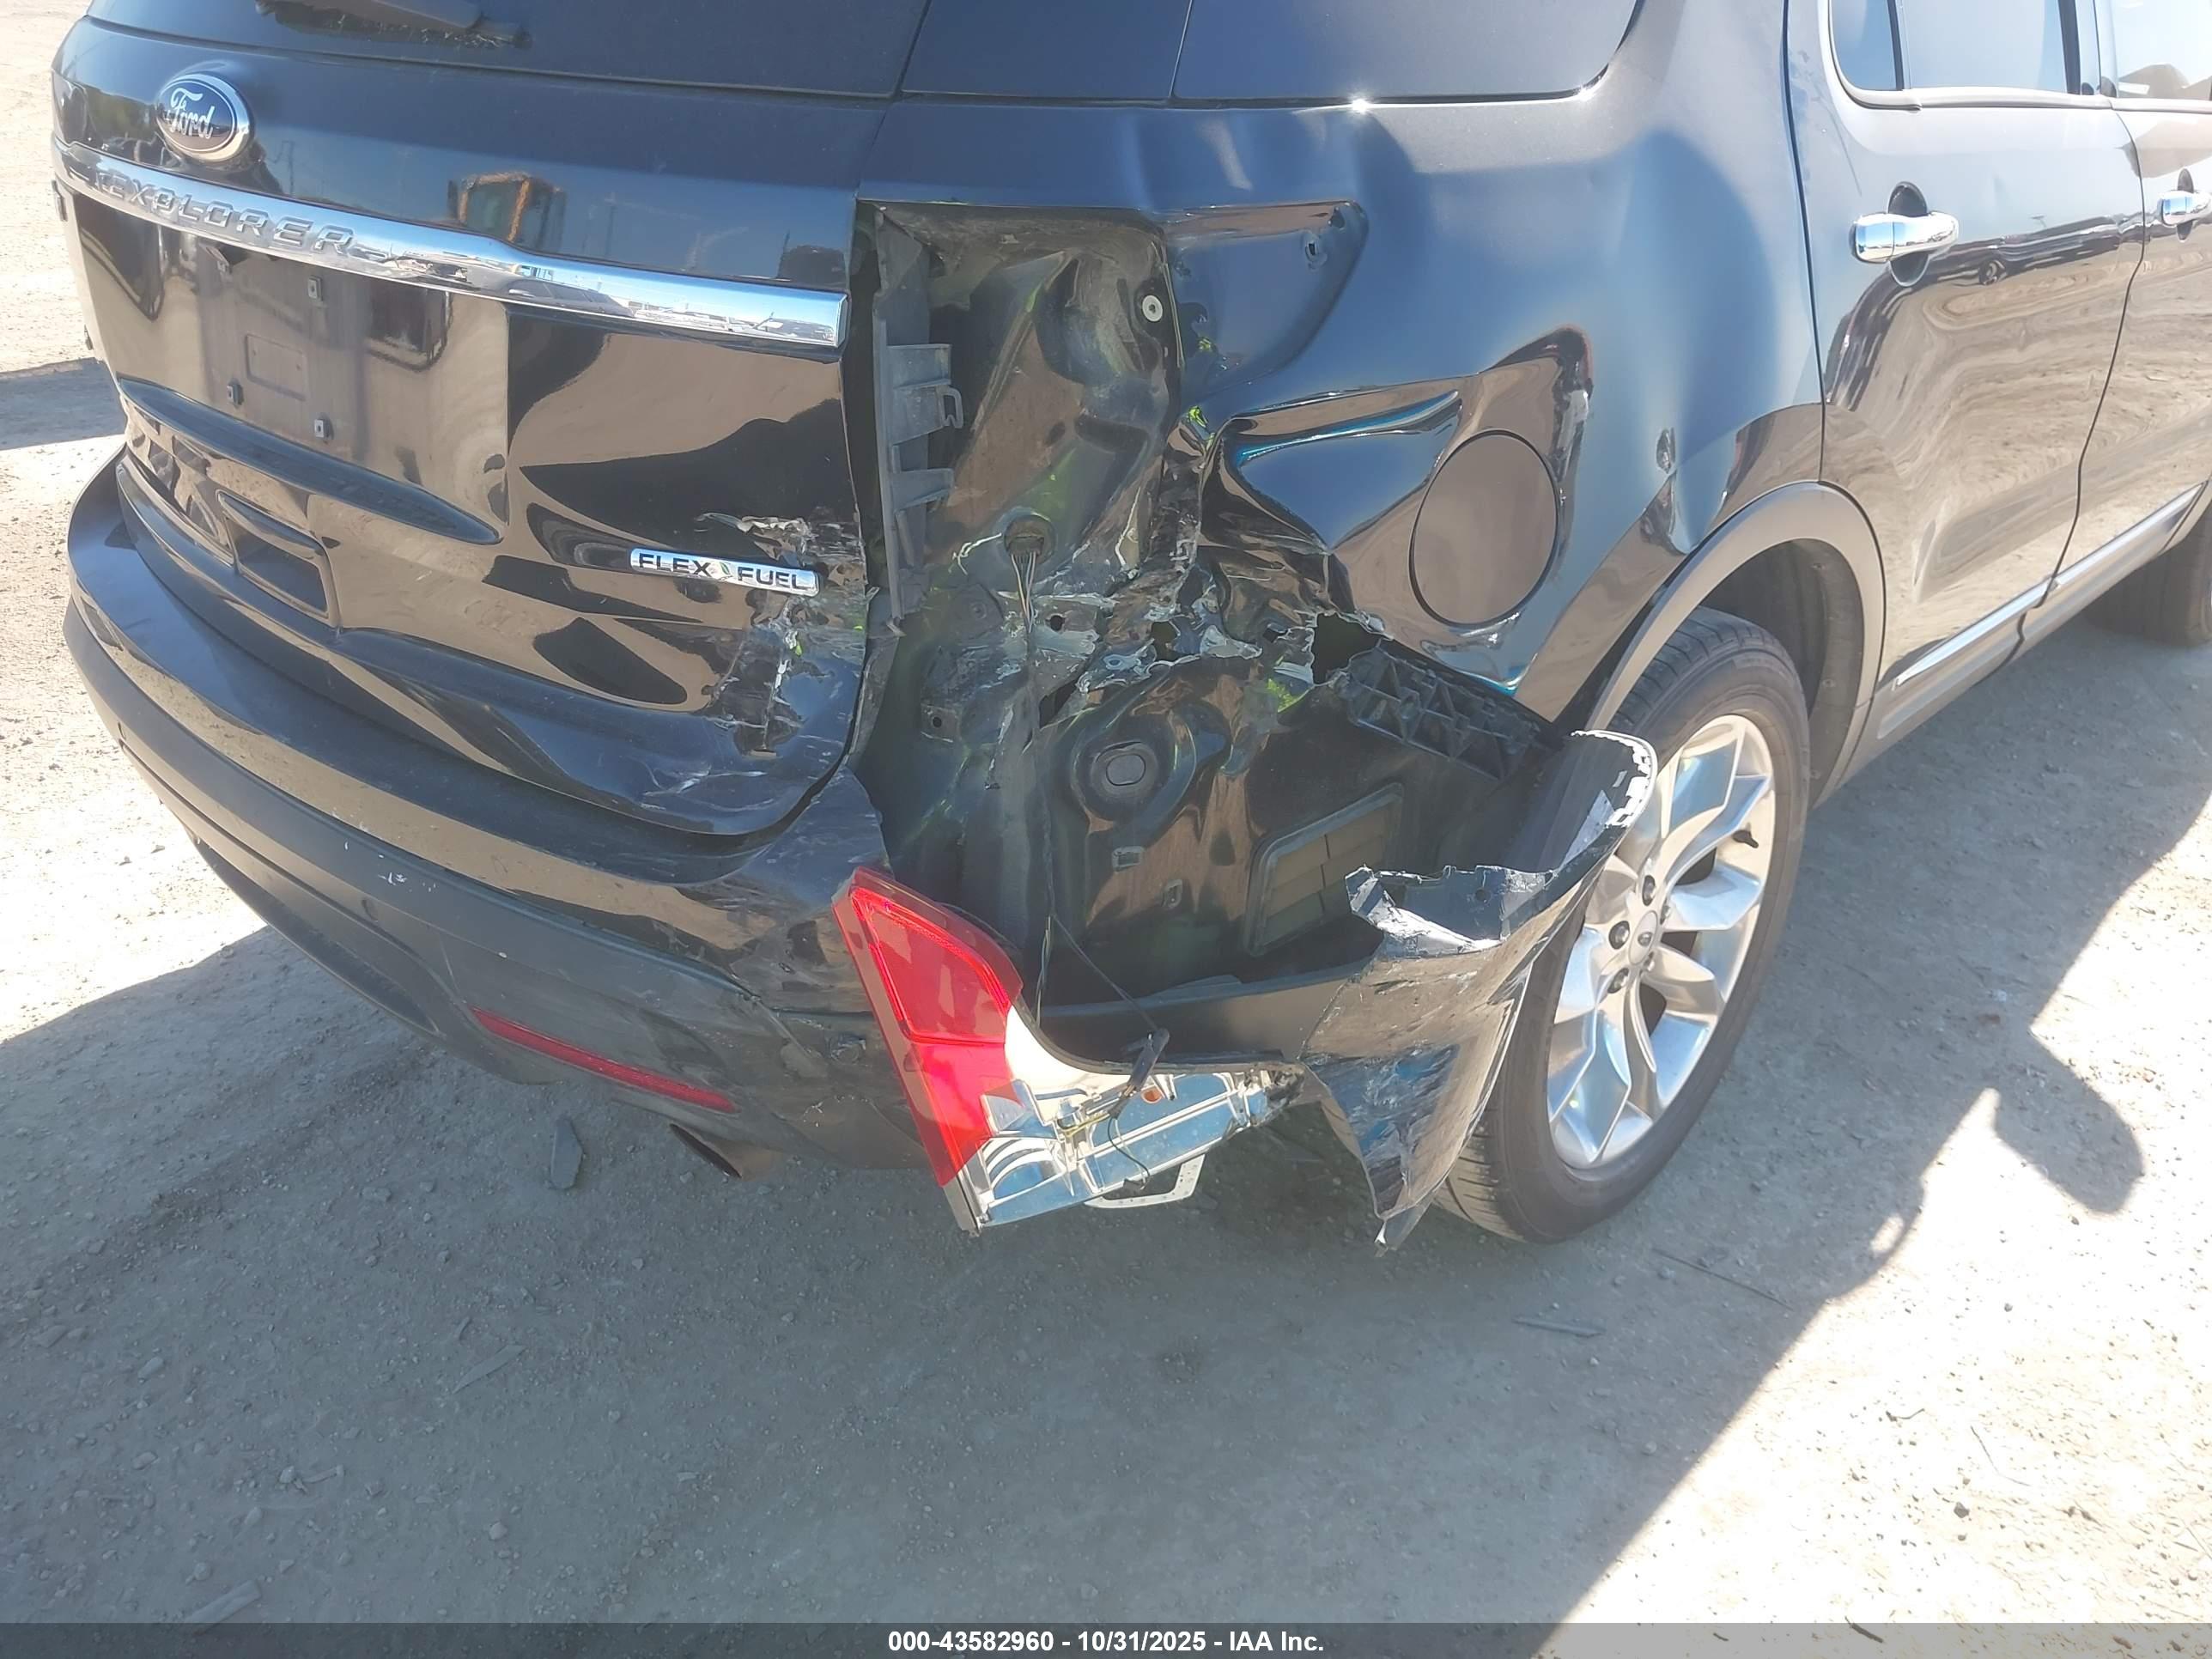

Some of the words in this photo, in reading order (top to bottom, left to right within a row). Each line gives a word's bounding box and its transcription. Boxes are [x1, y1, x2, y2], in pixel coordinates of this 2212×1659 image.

[170, 87, 216, 139] Ford
[100, 170, 354, 256] EXPLORER
[639, 553, 712, 578] FLEX
[737, 566, 810, 591] FUEL
